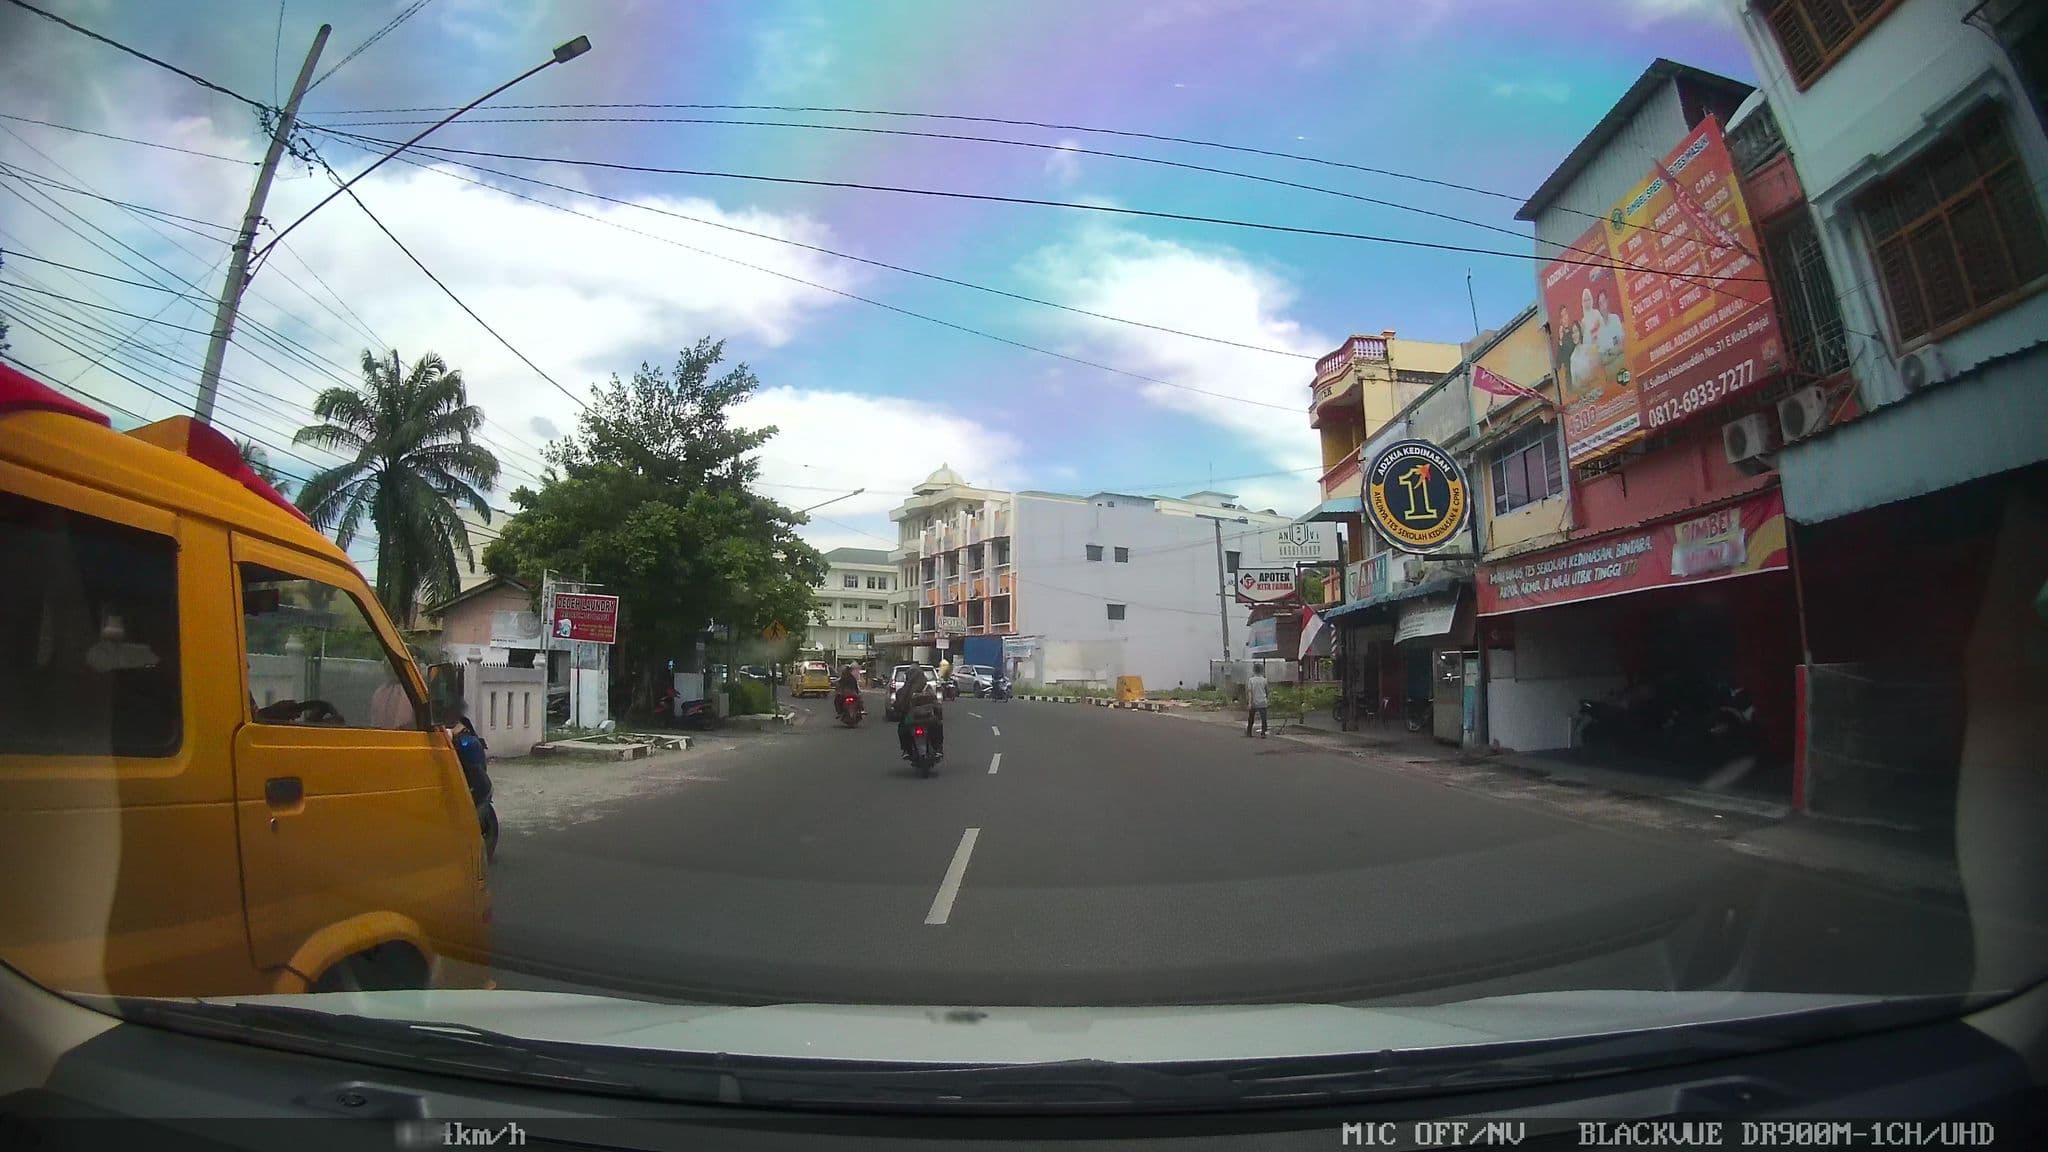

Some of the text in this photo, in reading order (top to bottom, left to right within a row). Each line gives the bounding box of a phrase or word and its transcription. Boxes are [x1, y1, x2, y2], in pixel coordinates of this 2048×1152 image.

[1684, 132, 1710, 161] MASUK
[1673, 325, 1700, 347] ADZKIA
[1699, 313, 1719, 333] KOTA
[1649, 372, 1669, 389] Sultan
[1731, 328, 1748, 343] Kota
[1747, 314, 1770, 334] Binjai
[1648, 359, 1754, 428] 0812-6933-7277
[1378, 447, 1451, 476] ADZKIA KEDINASAN
[1387, 518, 1398, 530] TES
[1398, 528, 1428, 541] SEKOLAH
[1428, 512, 1457, 539] KEDINASAN
[1258, 572, 1291, 582] APOTEK
[1525, 564, 1536, 578] TES
[1536, 556, 1567, 574] SEKOLAH
[1571, 568, 1593, 585] UTBK
[1593, 562, 1622, 581] TINGGI
[582, 598, 616, 613] LAUNDRY
